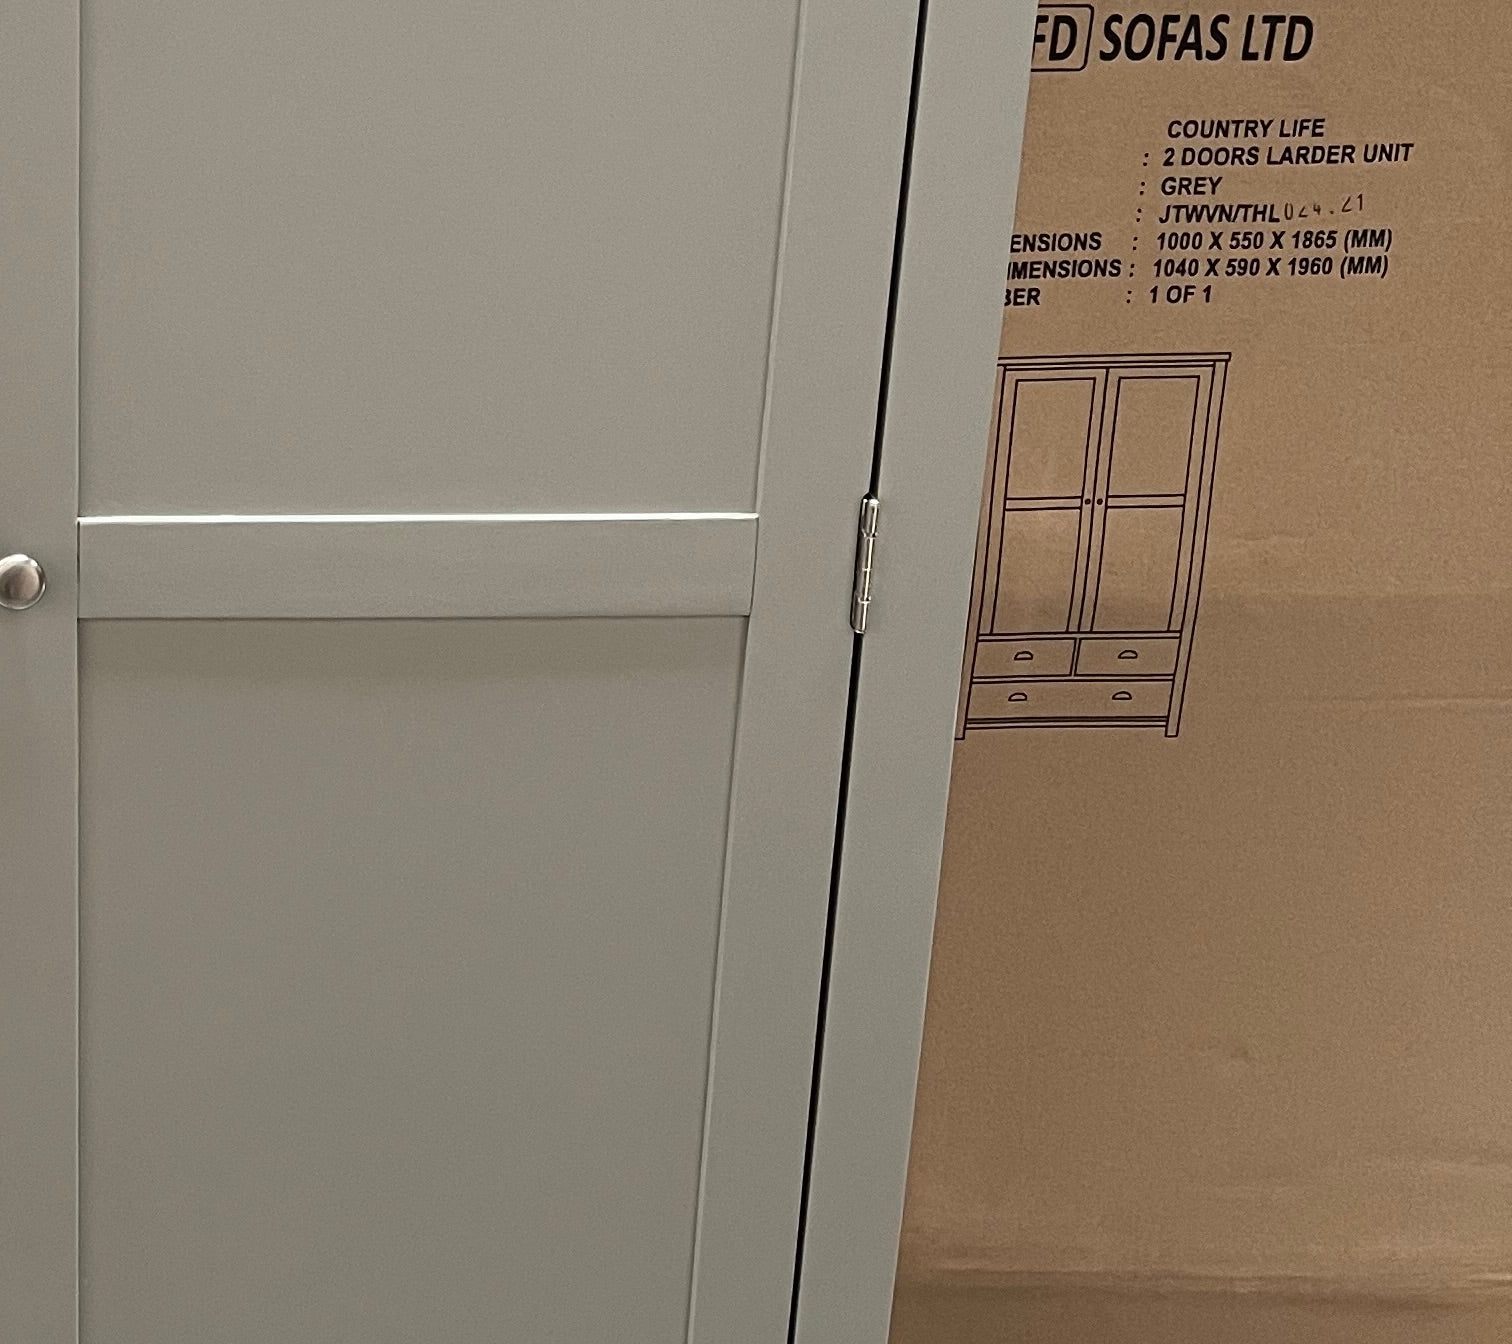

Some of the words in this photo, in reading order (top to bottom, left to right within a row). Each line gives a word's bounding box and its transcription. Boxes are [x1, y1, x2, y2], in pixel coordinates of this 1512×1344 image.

[1099, 13, 1231, 62] SOFAS
[1241, 14, 1314, 62] LTD
[1167, 118, 1275, 139] COUNTRY
[1278, 117, 1326, 139] LIFE
[1162, 147, 1176, 167] 2
[1180, 146, 1260, 166] DOORS
[1266, 144, 1356, 166] LARDER
[1363, 142, 1415, 163] UNIT
[1160, 176, 1223, 196] GREY
[1010, 231, 1103, 254] ENSIONS
[1157, 231, 1203, 251] 1000
[1208, 231, 1224, 250] X
[1228, 231, 1265, 250] 550
[1269, 230, 1287, 250] X
[1291, 229, 1339, 249] 1865
[1343, 228, 1393, 254] (MM)
[1153, 258, 1200, 278] 1040
[1203, 257, 1221, 277] X
[1224, 257, 1261, 277] 590
[1265, 257, 1282, 277] X
[1287, 256, 1334, 276] 1960
[1339, 255, 1389, 280] (MM)
[1149, 285, 1159, 304] 1
[1166, 284, 1197, 304] OF
[1202, 284, 1212, 304] 1
